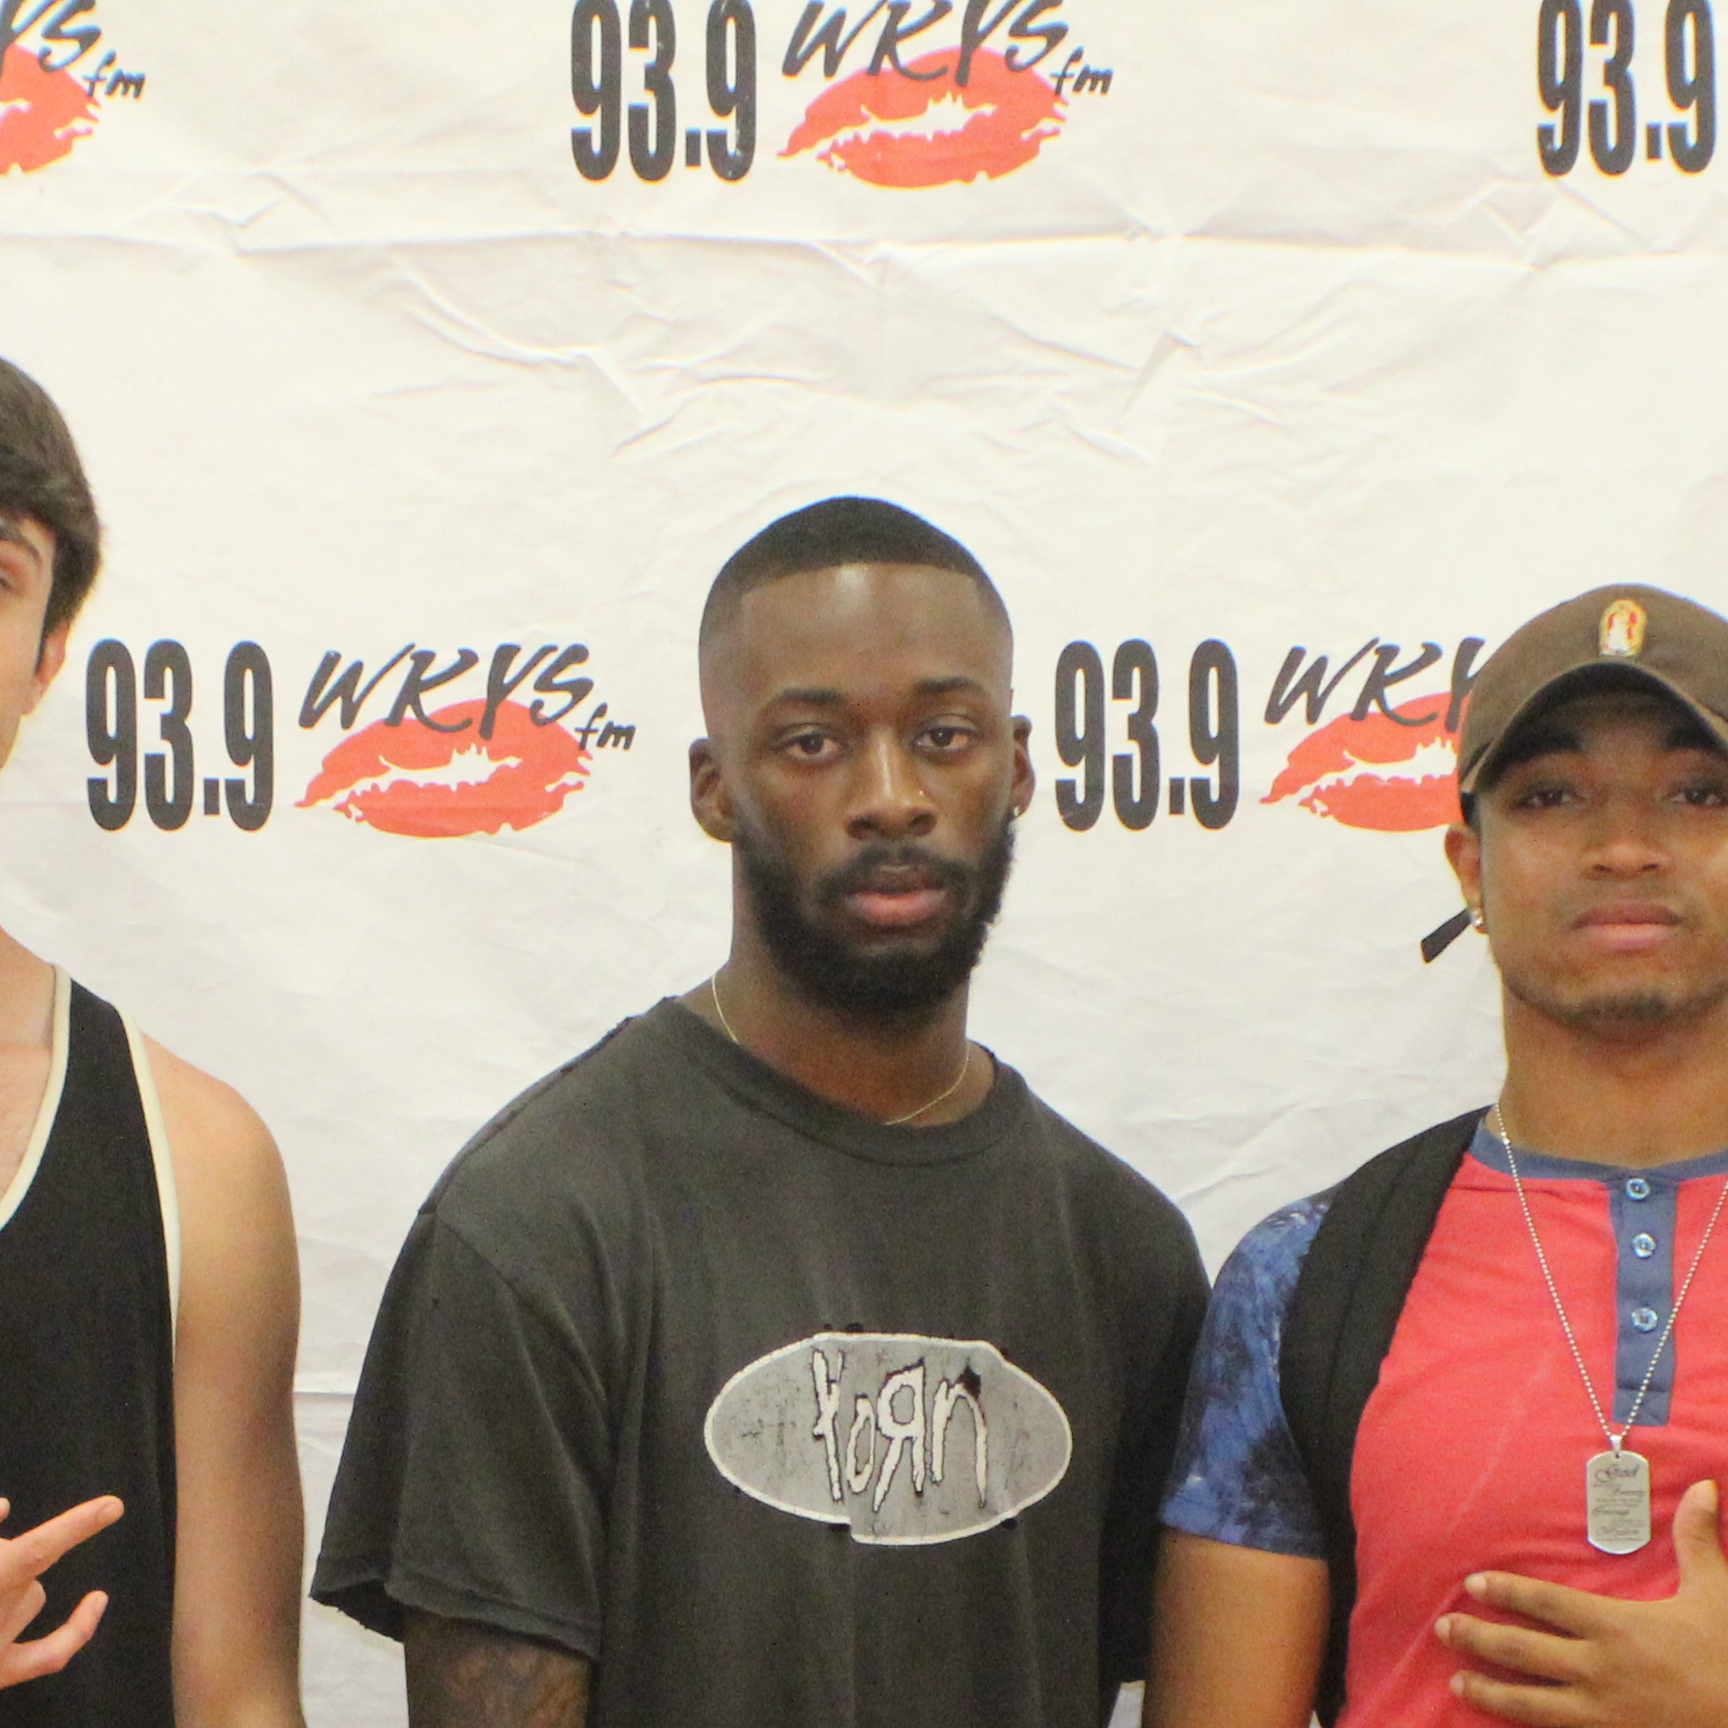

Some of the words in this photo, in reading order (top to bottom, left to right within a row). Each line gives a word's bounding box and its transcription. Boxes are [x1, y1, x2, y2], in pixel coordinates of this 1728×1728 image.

[570, 0, 757, 182] 93.9
[782, 0, 1069, 87] WKYS
[1537, 0, 1717, 176] 93.9
[86, 638, 274, 832] 93.9
[298, 643, 594, 740] WKYS
[1054, 638, 1239, 831] 93.9
